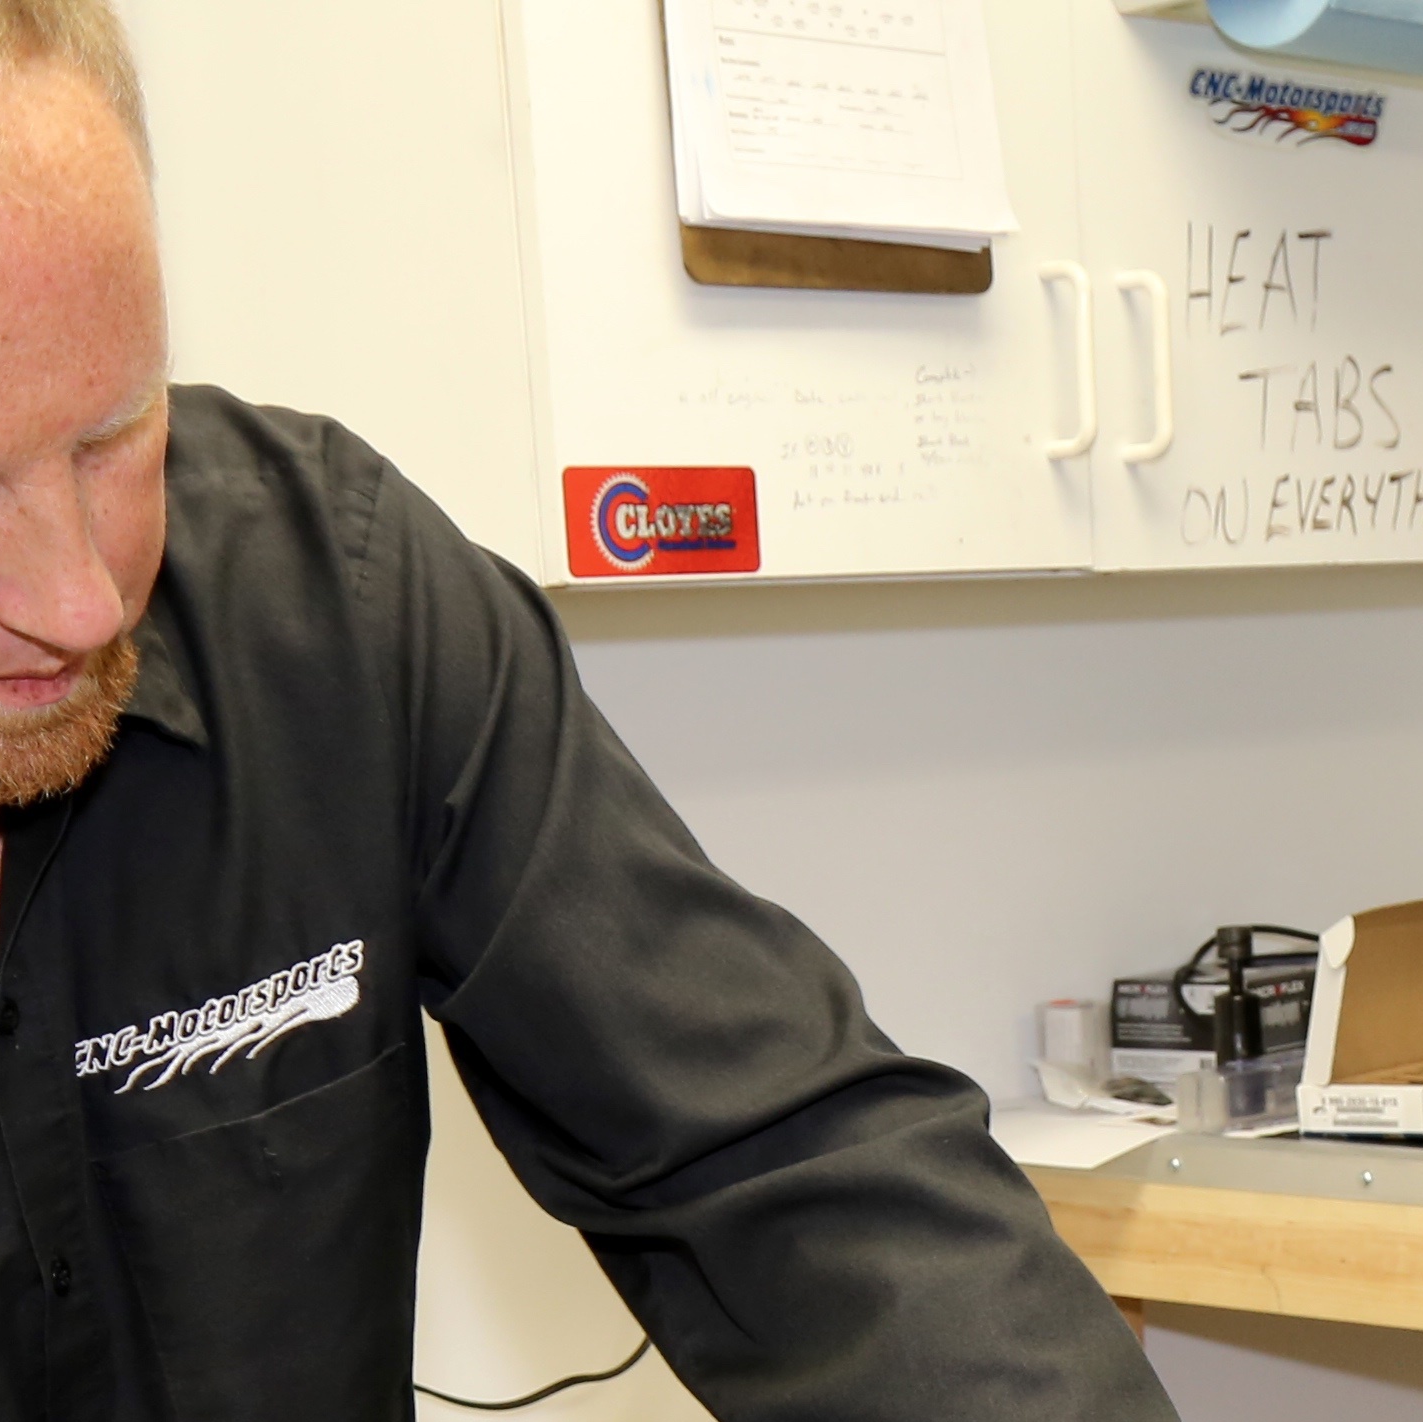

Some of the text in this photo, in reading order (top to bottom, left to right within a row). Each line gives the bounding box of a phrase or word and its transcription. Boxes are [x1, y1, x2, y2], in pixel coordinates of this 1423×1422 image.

[1189, 68, 1386, 118] CNC-Motorsports
[1185, 221, 1332, 336] HEAT
[1238, 354, 1402, 452] TABS
[615, 502, 733, 540] CLOYES
[1180, 477, 1249, 547] ON
